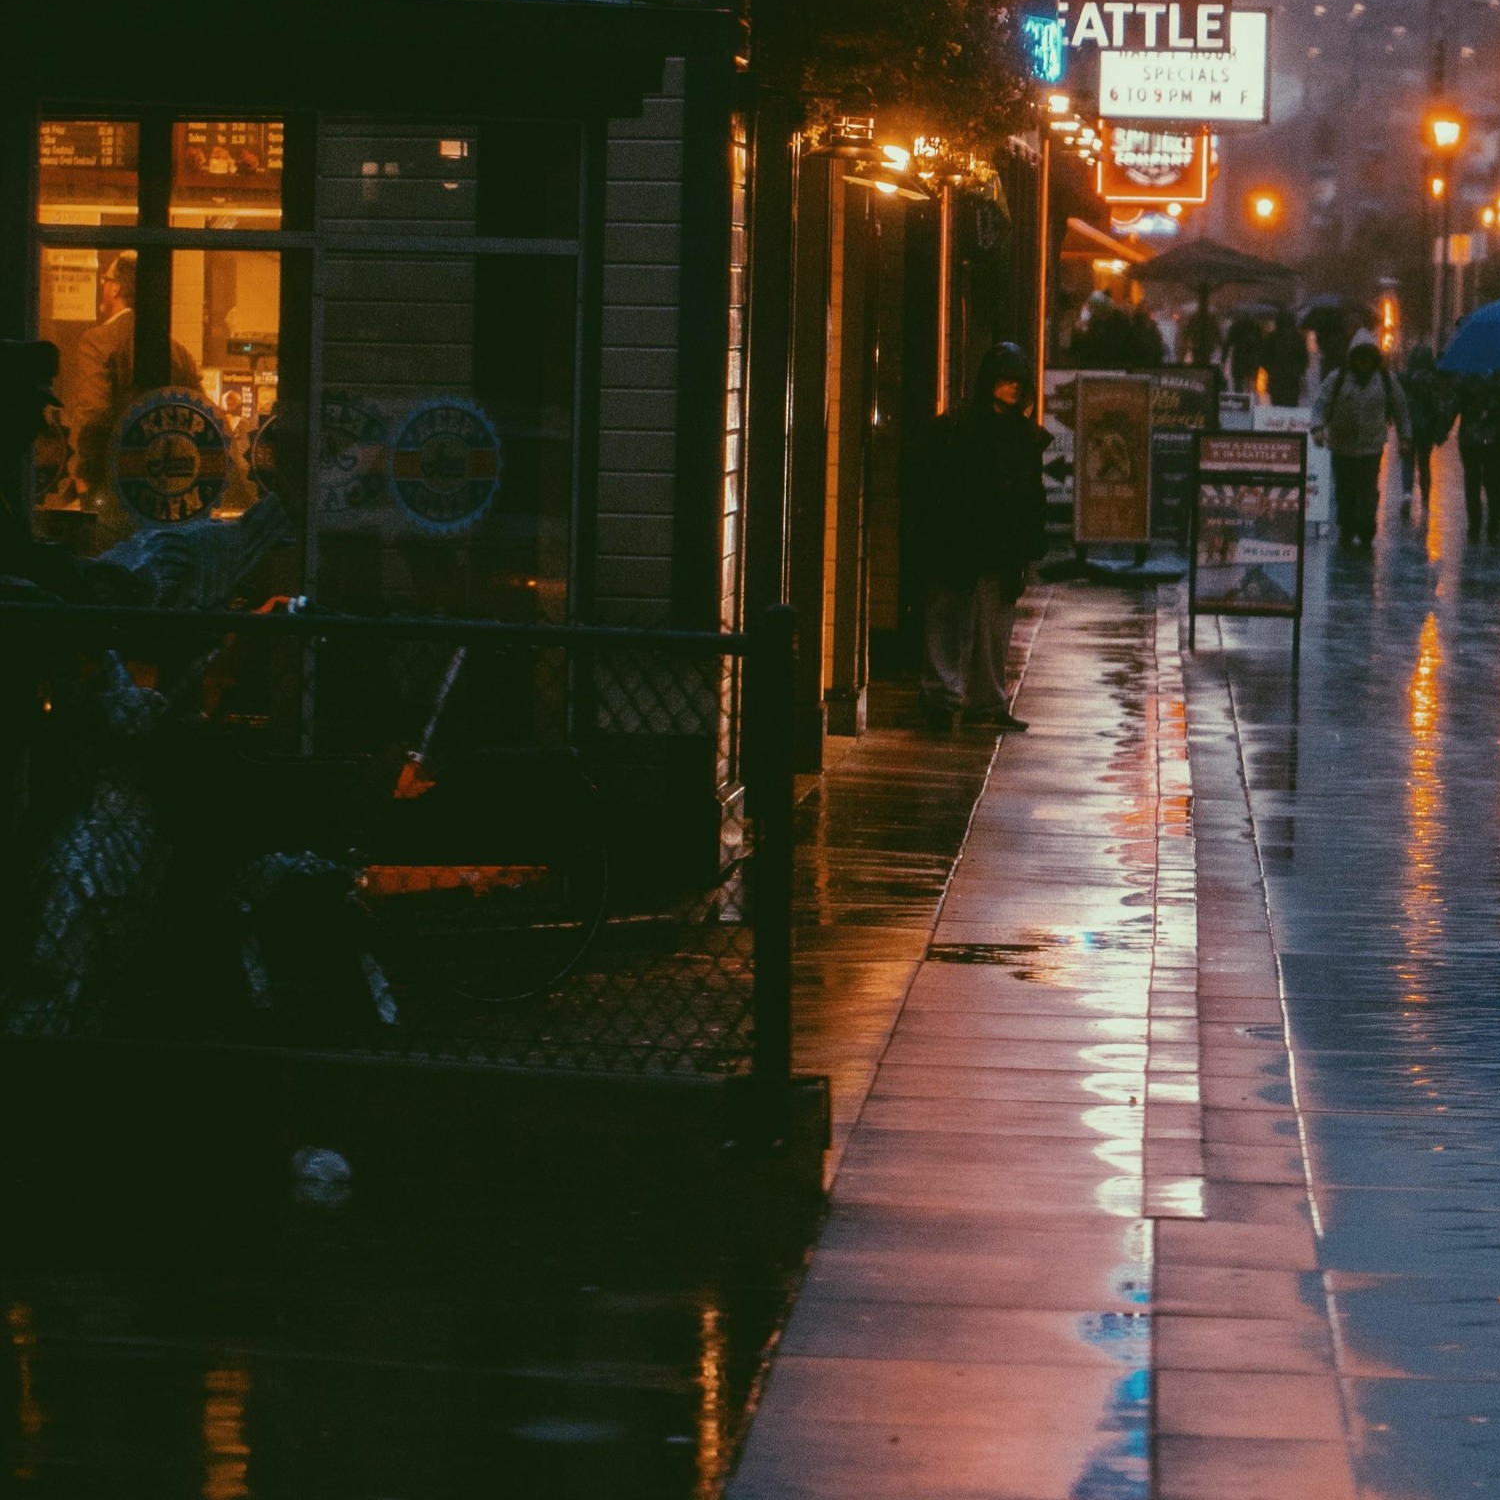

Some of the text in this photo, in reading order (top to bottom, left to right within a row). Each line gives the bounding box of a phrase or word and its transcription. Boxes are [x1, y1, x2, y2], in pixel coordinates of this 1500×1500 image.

[1057, 1, 1224, 48] ATTLE
[1143, 66, 1230, 82] SPECIALS
[1126, 88, 1147, 103] TO
